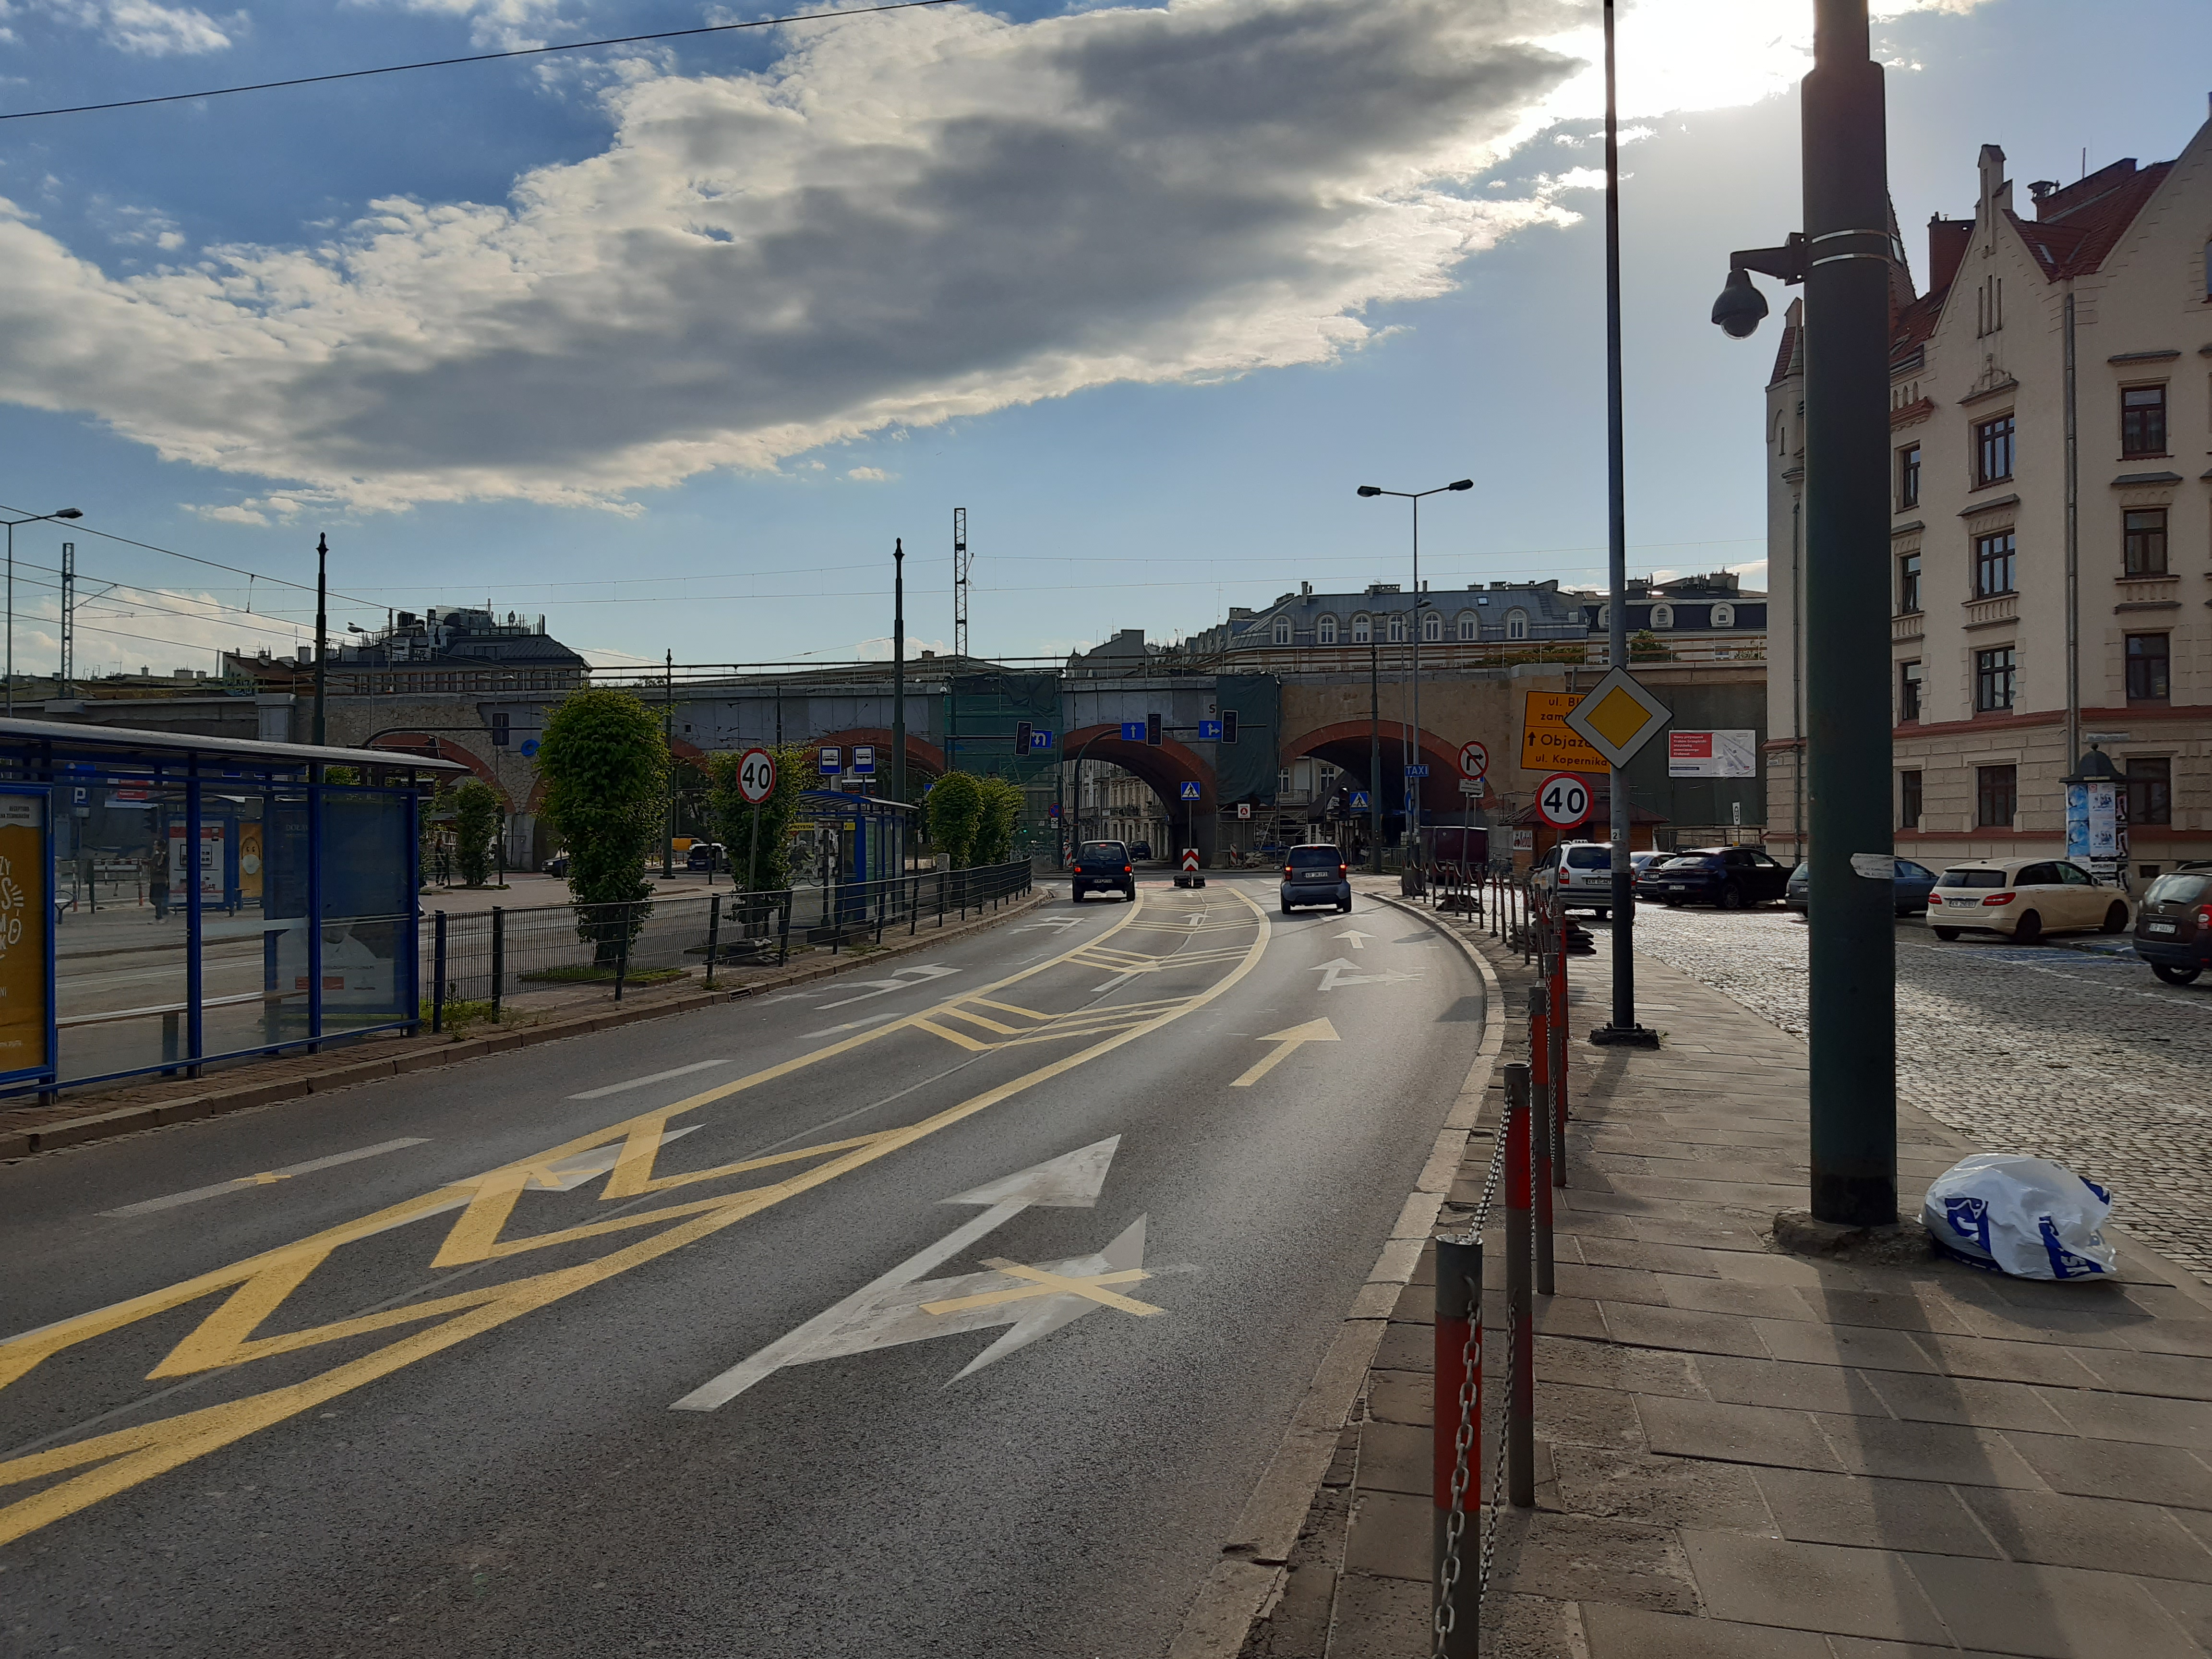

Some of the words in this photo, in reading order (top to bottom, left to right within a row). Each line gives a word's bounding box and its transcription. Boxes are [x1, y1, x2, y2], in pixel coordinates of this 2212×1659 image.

[1549, 697, 1562, 706] ul.
[1568, 697, 1583, 707] Bl
[1540, 712, 1568, 721] zam
[1536, 754, 1548, 762] ul.
[1552, 755, 1607, 766] Kopernika
[742, 762, 771, 790] 40
[1406, 766, 1428, 775] TAXI
[1543, 787, 1585, 814] 40
